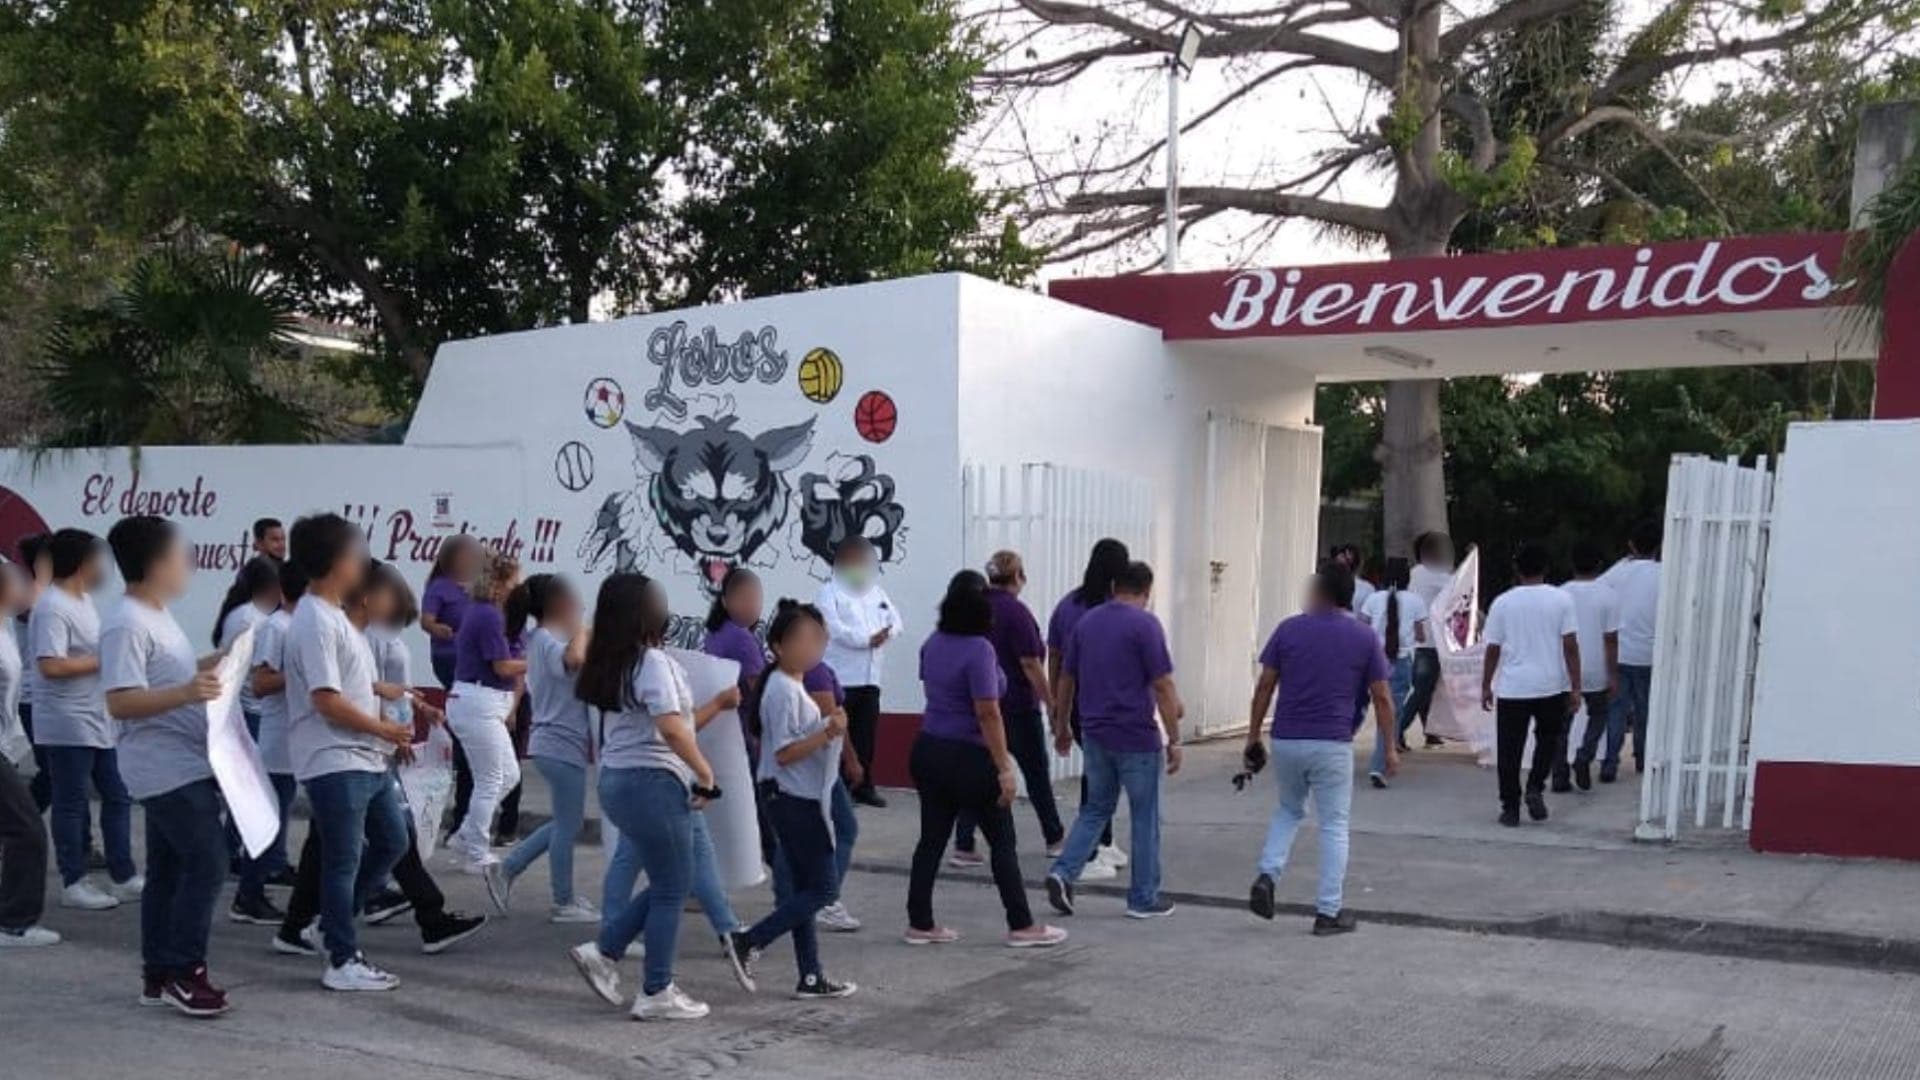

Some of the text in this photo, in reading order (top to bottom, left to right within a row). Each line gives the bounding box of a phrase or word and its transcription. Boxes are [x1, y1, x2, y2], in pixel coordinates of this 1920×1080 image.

[1209, 241, 1857, 331] Bienvenidos
[645, 320, 788, 418] Lobos
[82, 469, 217, 518] El deporte
[192, 530, 252, 572] uest
[531, 518, 561, 562] !!!
